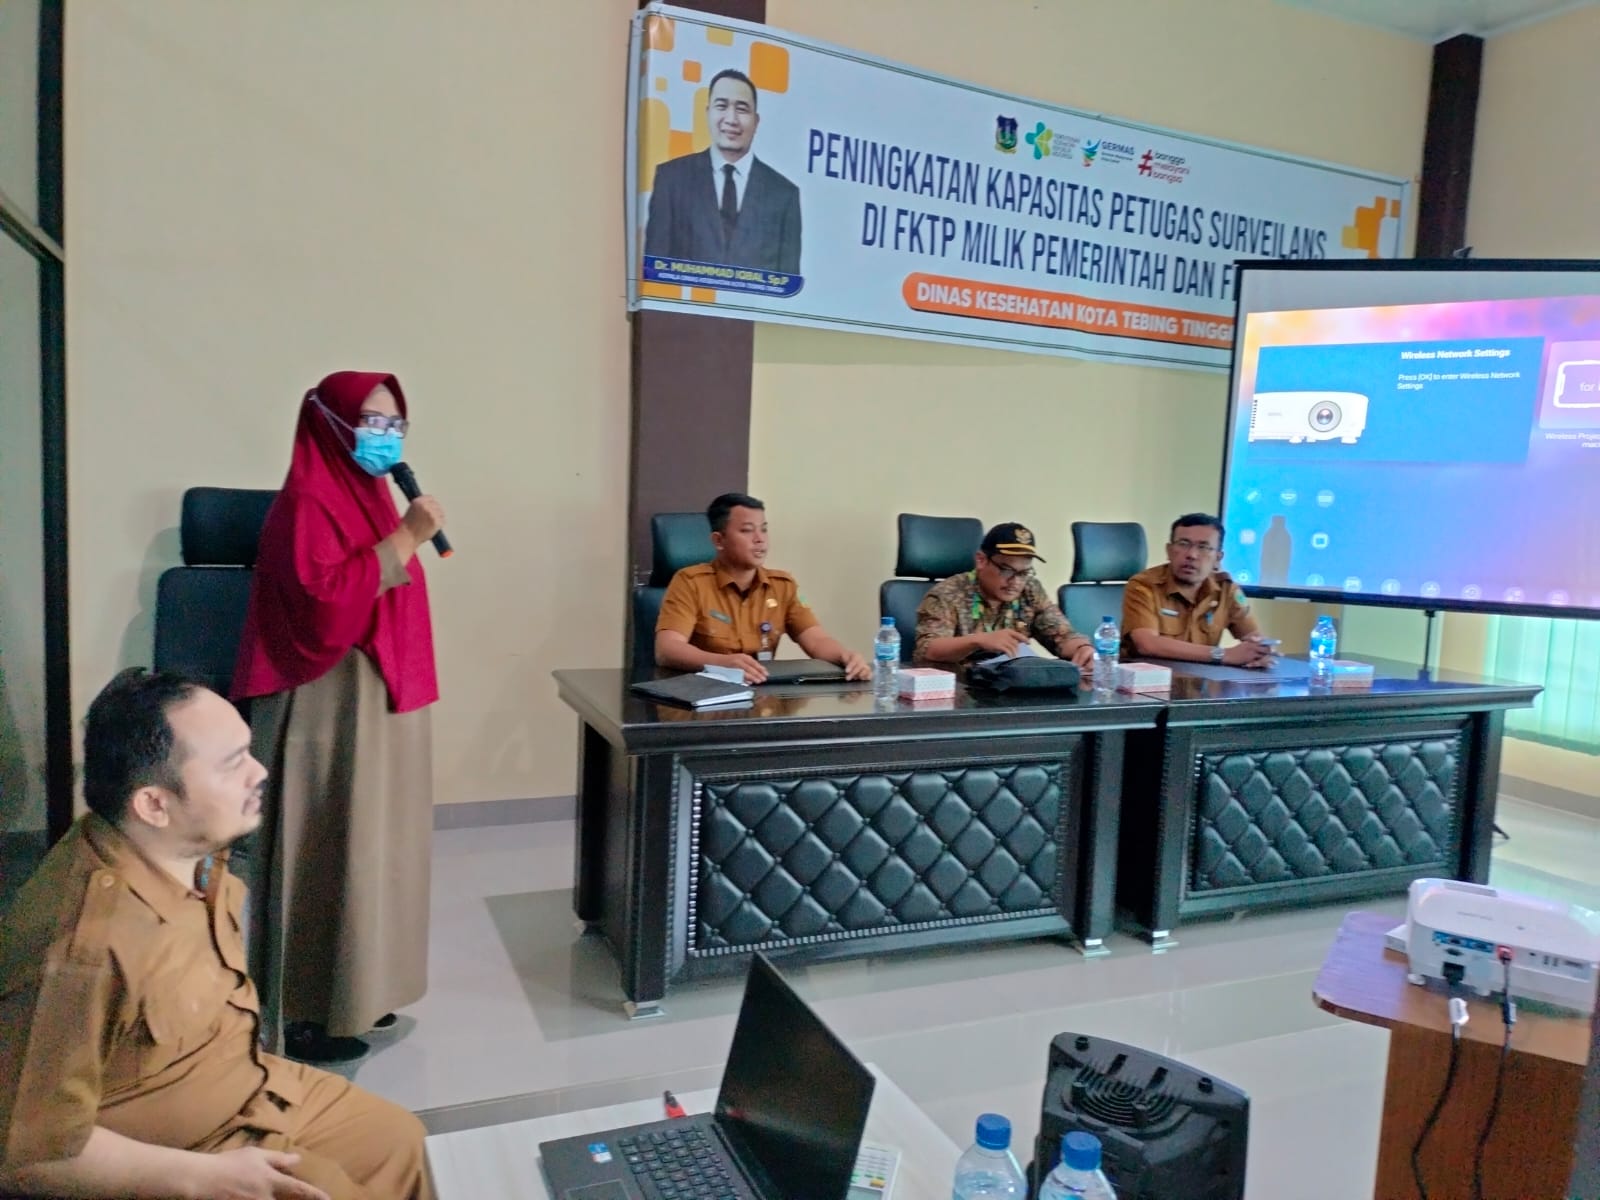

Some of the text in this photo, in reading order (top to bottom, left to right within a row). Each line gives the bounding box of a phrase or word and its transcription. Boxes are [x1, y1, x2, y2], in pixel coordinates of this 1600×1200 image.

[1102, 140, 1135, 155] GERMAS
[808, 128, 1327, 260] PENINGKATAN KAPASITAS PETUGAS SURVEILANS
[861, 202, 1236, 301] DI FKTP MILIK PEMERINTAH DAN F
[671, 262, 734, 278] MUHAMMAD
[917, 283, 971, 307] DINAS
[975, 289, 1073, 320] KESEHATAN
[1076, 303, 1118, 326] KOTA
[1122, 310, 1178, 334] TEBING
[1401, 349, 1511, 360] Wireless Network Settings
[1460, 372, 1489, 380] Wireless
[1490, 371, 1520, 379] Network
